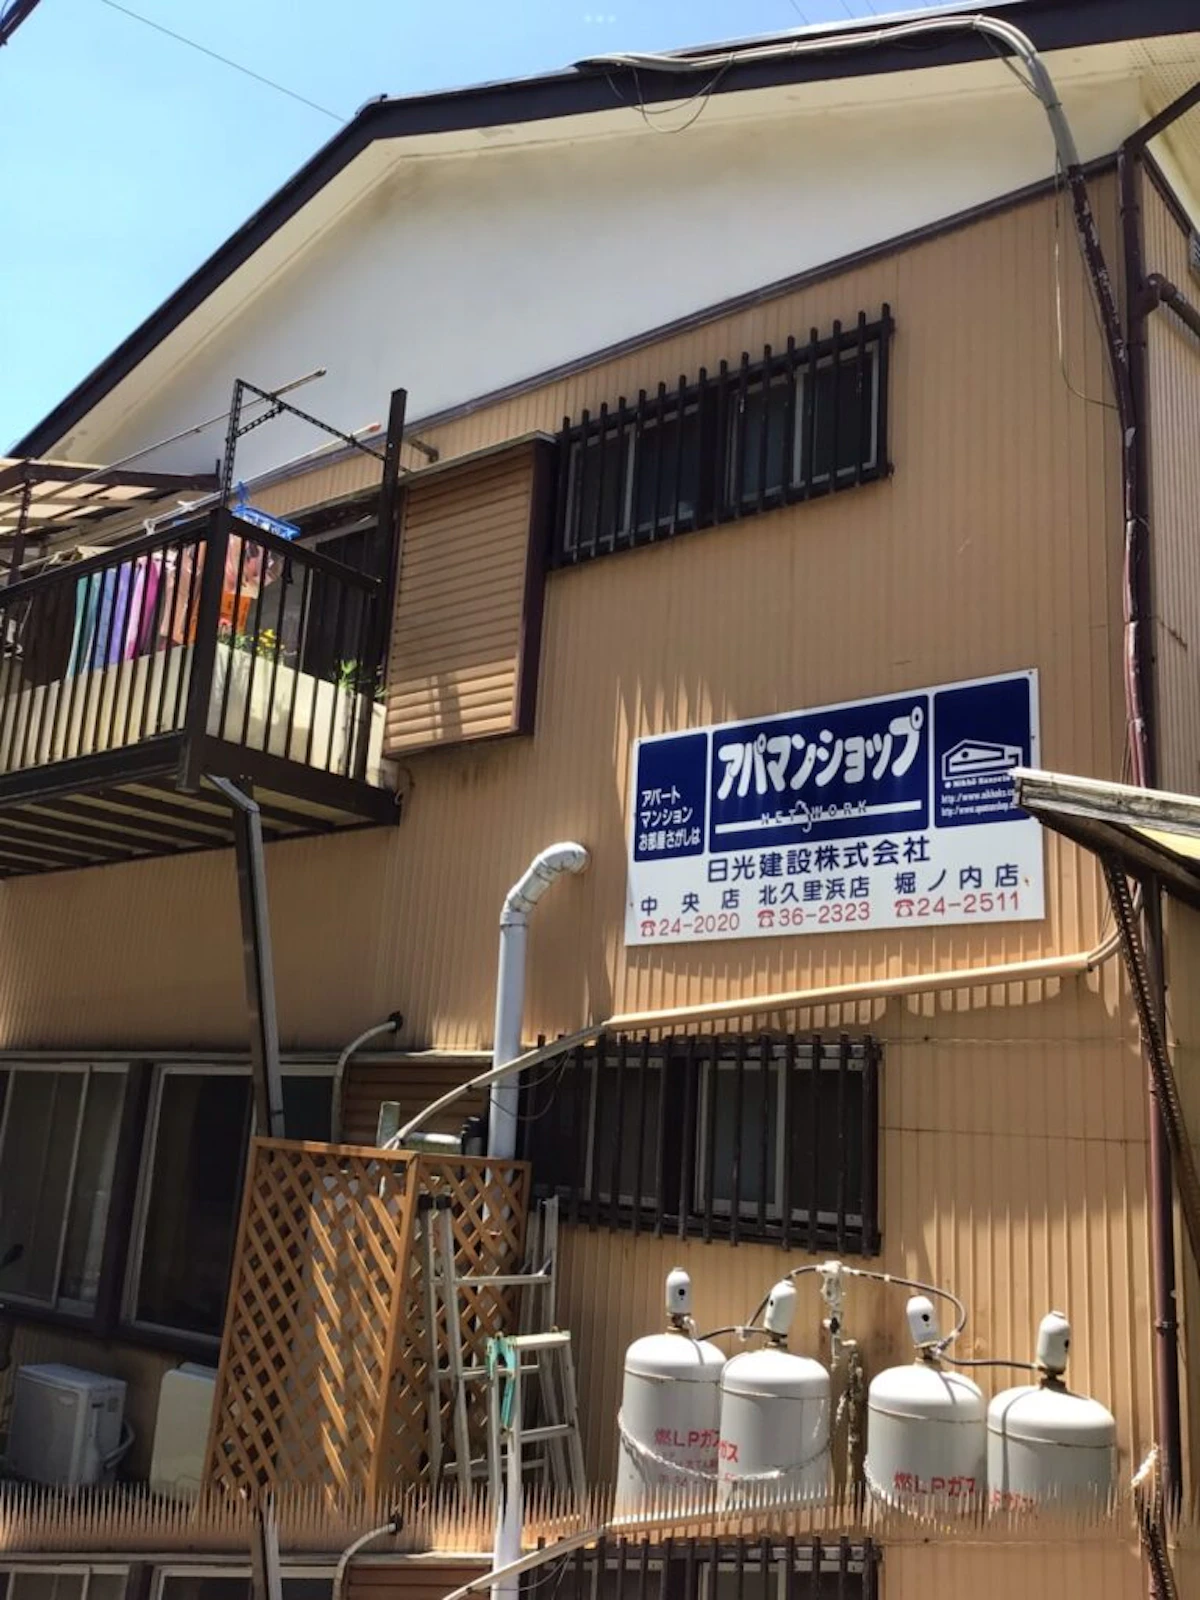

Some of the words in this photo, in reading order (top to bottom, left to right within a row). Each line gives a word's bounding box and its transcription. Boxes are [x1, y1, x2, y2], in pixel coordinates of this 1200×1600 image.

[717, 705, 925, 801] アパマンショップ
[639, 805, 694, 829] マンション
[637, 825, 701, 852] お部屋さがしは
[707, 835, 930, 883] 日光建設株式会社
[758, 876, 871, 906] 北久里浜店
[658, 912, 740, 937] 24-2020
[778, 901, 871, 927] 36-2323
[917, 891, 1020, 917] 24-2511
